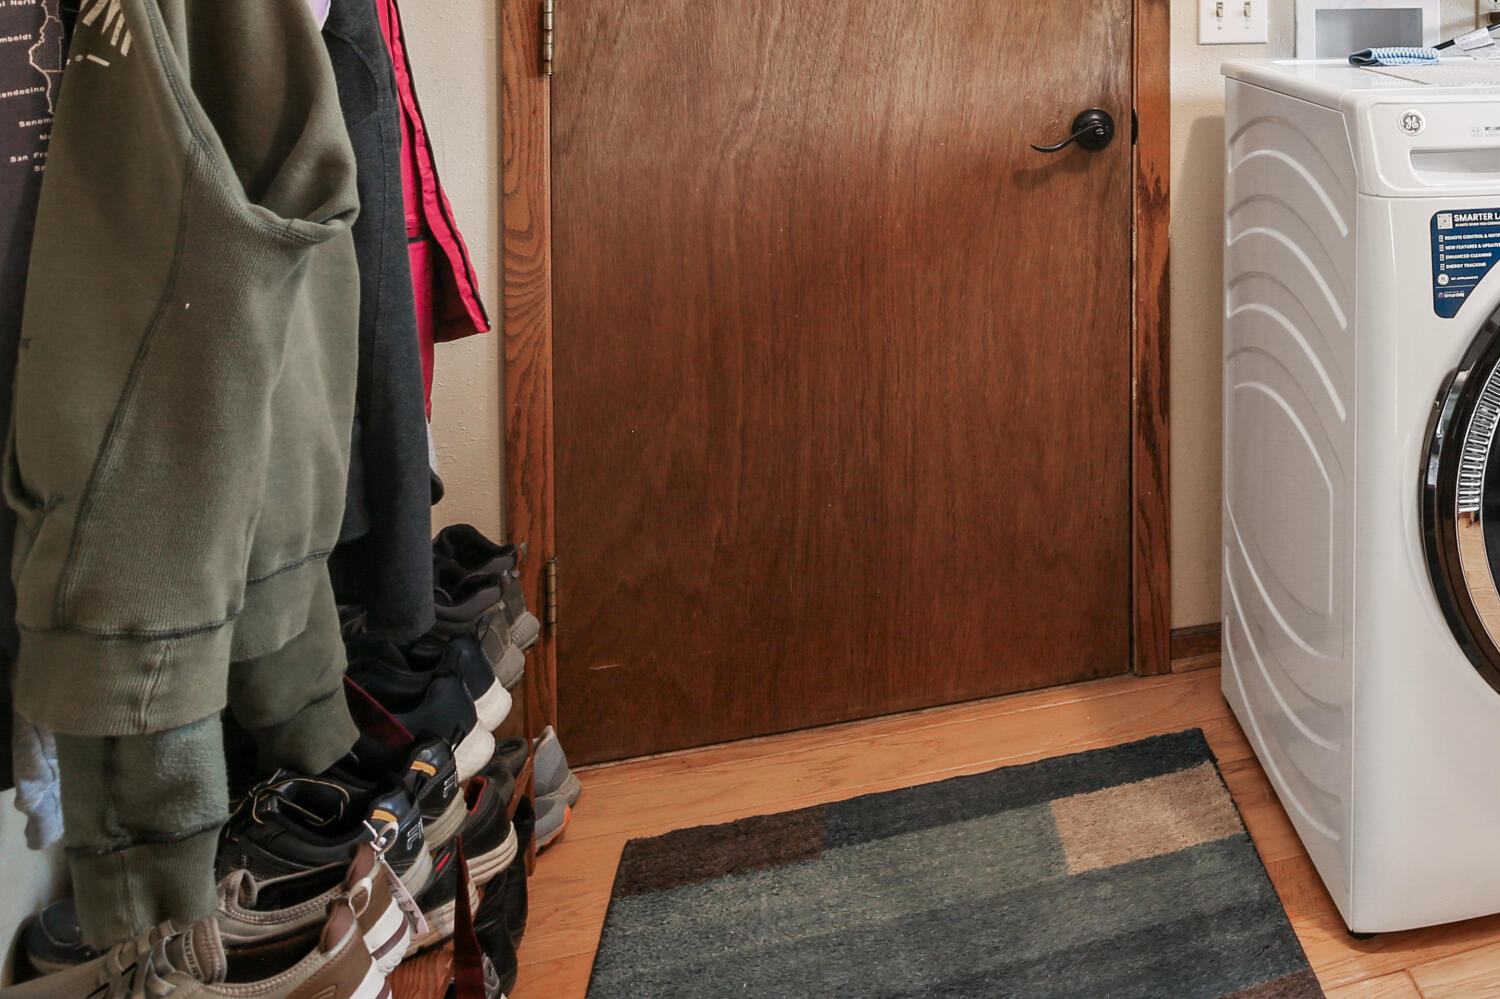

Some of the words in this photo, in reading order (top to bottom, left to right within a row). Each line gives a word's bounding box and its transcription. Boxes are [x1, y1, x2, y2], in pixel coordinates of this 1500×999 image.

[0, 33, 32, 43] mboldt
[0, 86, 46, 99] endocino
[18, 117, 52, 128] Sonom
[10, 154, 28, 163] San
[1454, 212, 1492, 222] SMARTER
